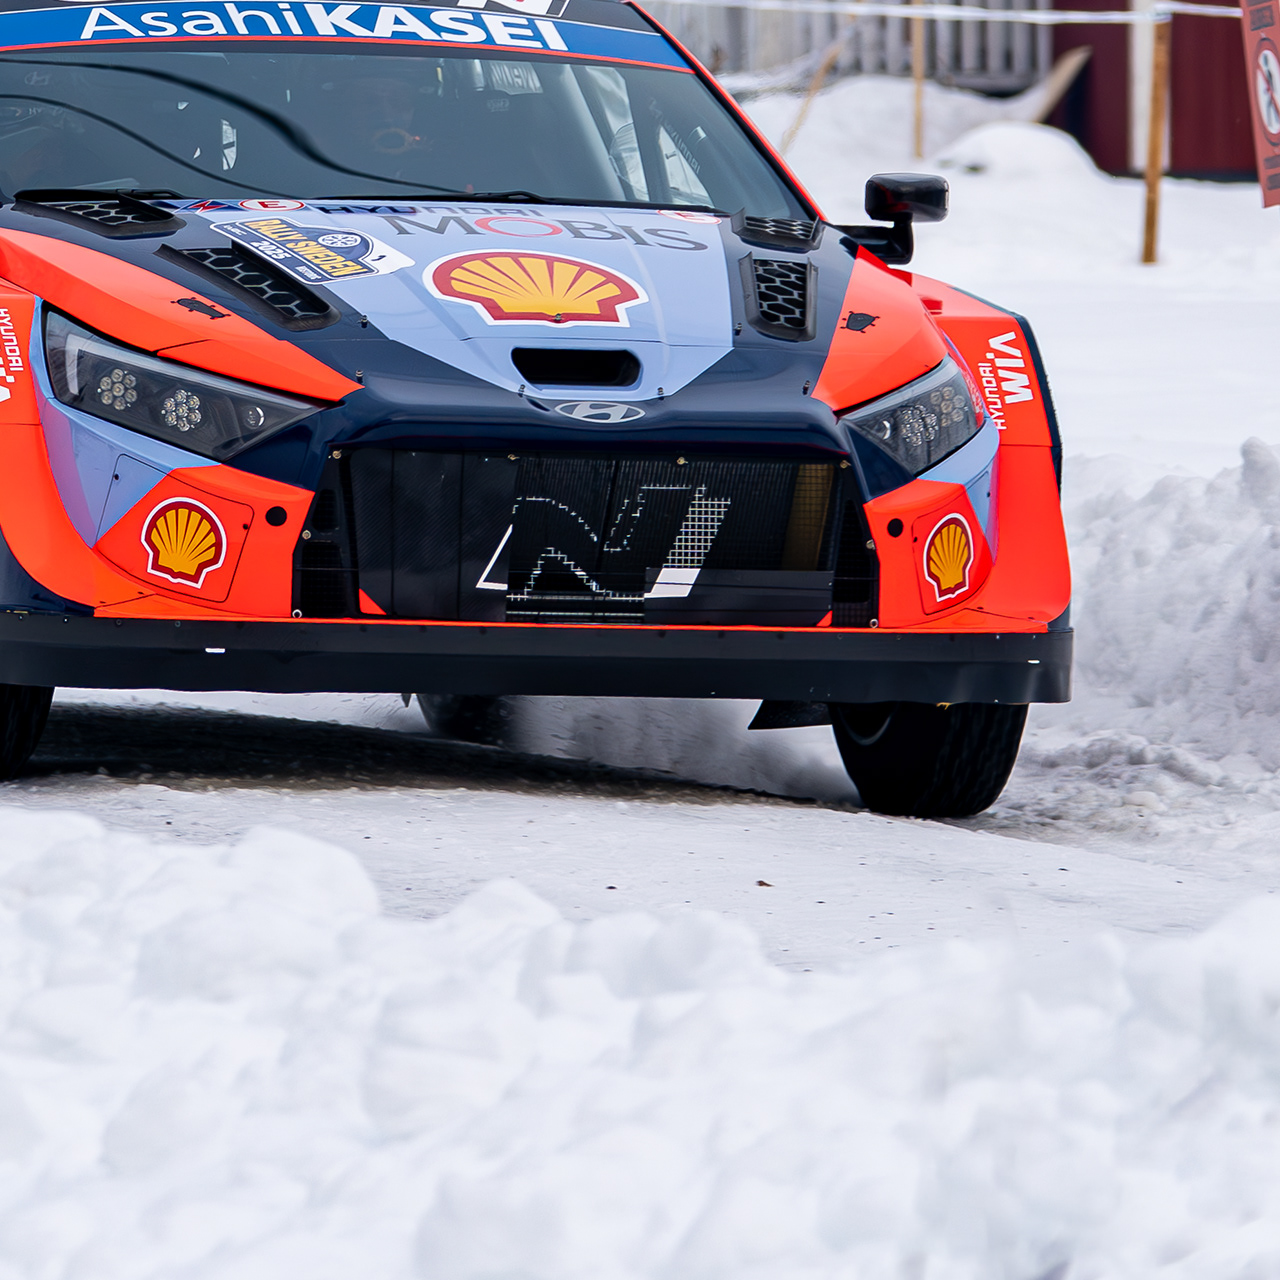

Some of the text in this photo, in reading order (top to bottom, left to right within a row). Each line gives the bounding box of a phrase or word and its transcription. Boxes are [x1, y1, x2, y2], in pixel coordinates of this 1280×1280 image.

[259, 200, 288, 209] E
[244, 219, 308, 241] RALLY
[285, 240, 369, 277] SWEDEN
[250, 240, 292, 260] 2025
[375, 215, 709, 251] MOBIS
[985, 331, 1034, 405] WIA
[977, 362, 1008, 430] HYUNDAI
